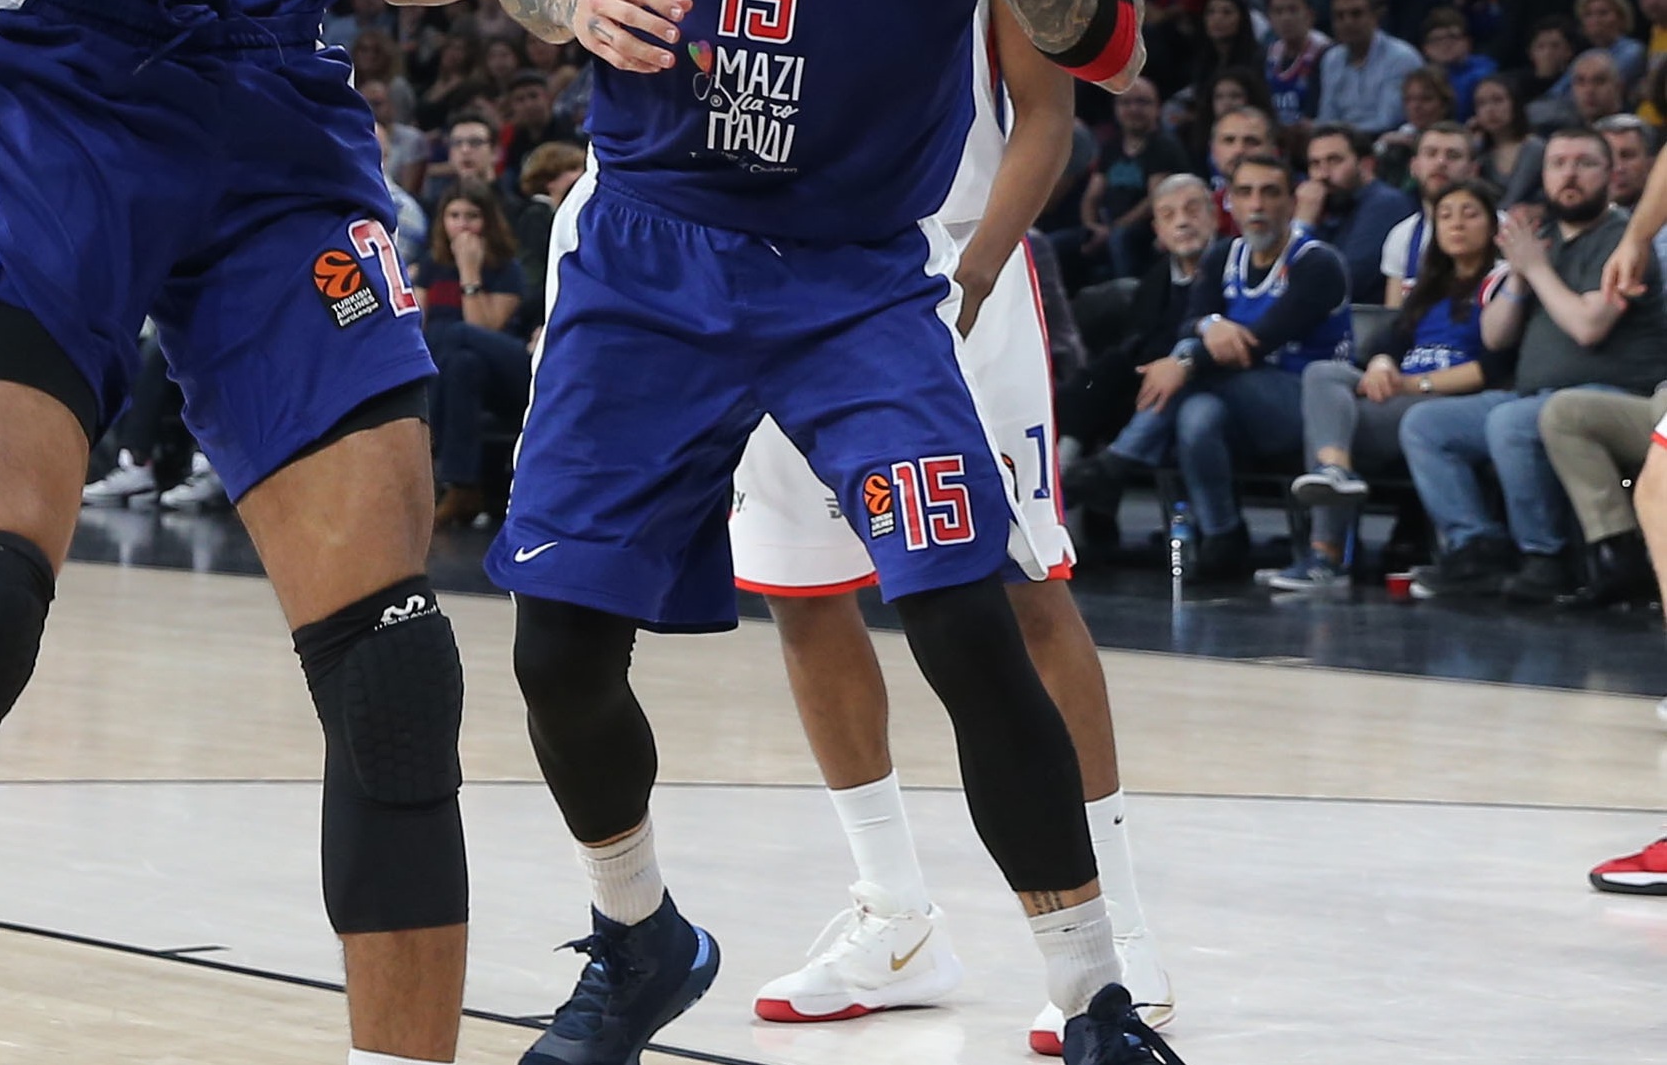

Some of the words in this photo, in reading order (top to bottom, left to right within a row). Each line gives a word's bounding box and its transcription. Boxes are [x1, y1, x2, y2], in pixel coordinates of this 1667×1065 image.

[348, 218, 421, 318] 2
[891, 454, 976, 552] 15
[1025, 424, 1051, 500] 1
